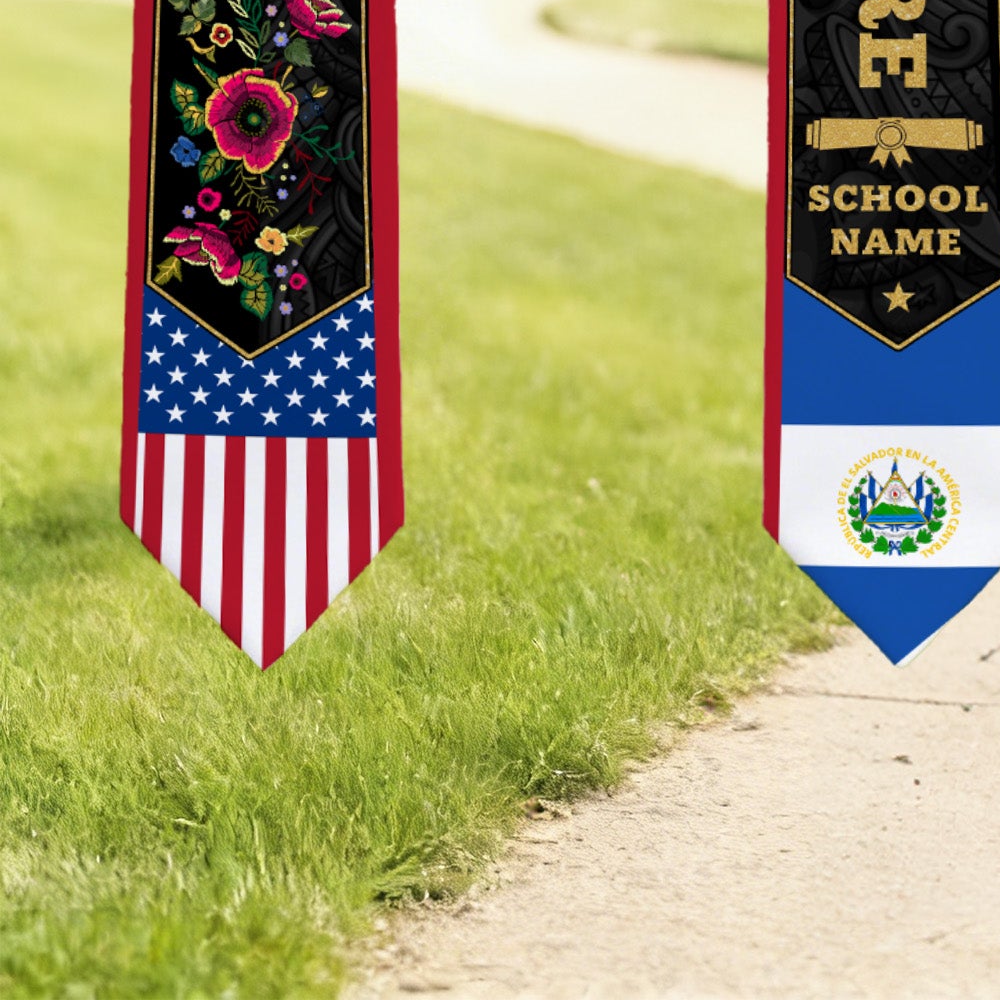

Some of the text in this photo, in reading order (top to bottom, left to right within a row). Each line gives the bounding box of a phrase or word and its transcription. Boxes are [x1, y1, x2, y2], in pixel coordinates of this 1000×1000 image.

[808, 184, 989, 213] SCHOOL
[831, 228, 961, 256] NAME
[848, 447, 903, 477] SALVADOR
[905, 448, 921, 461] EN
[922, 455, 938, 469] LA
[840, 477, 853, 490] EL
[837, 490, 847, 505] DE
[920, 518, 959, 559] CENTRAL
